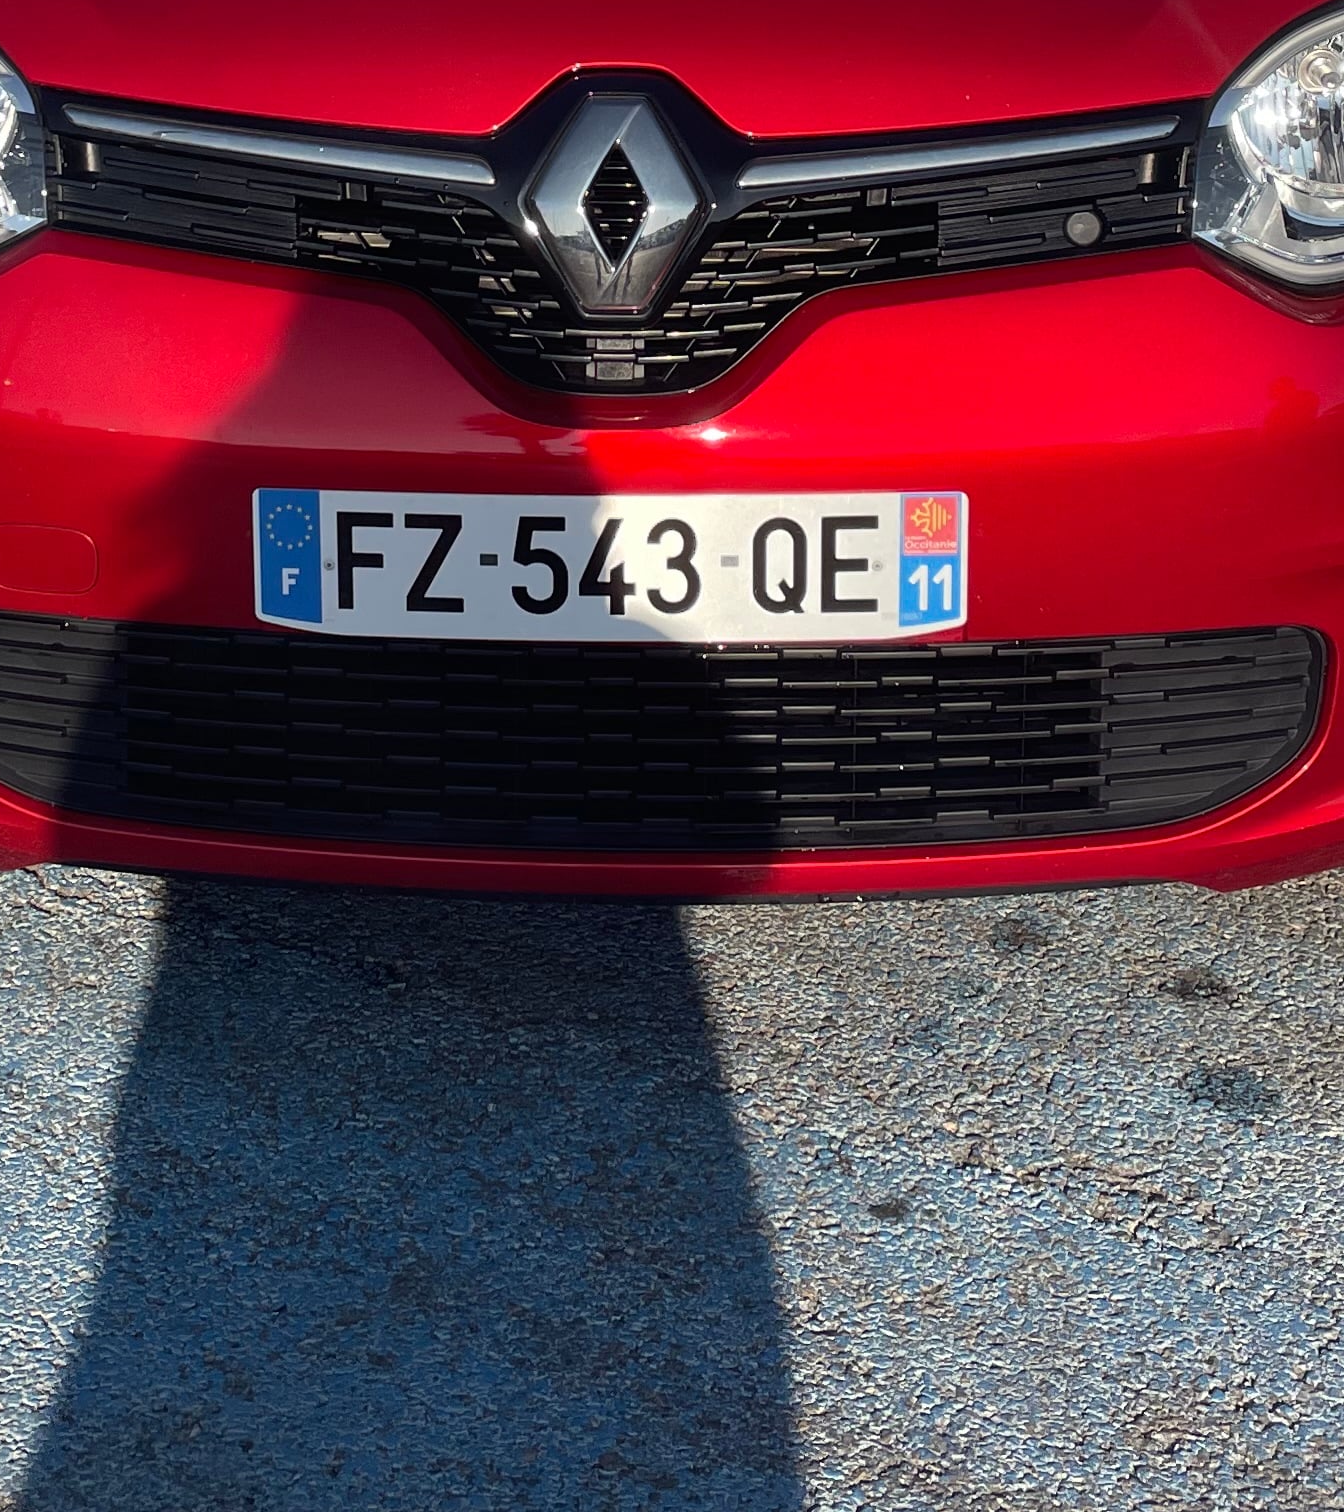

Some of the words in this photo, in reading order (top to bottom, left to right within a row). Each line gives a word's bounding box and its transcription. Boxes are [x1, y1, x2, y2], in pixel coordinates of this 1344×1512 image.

[904, 539, 957, 549] Occitanie
[282, 568, 300, 595] F
[908, 564, 953, 611] 11
